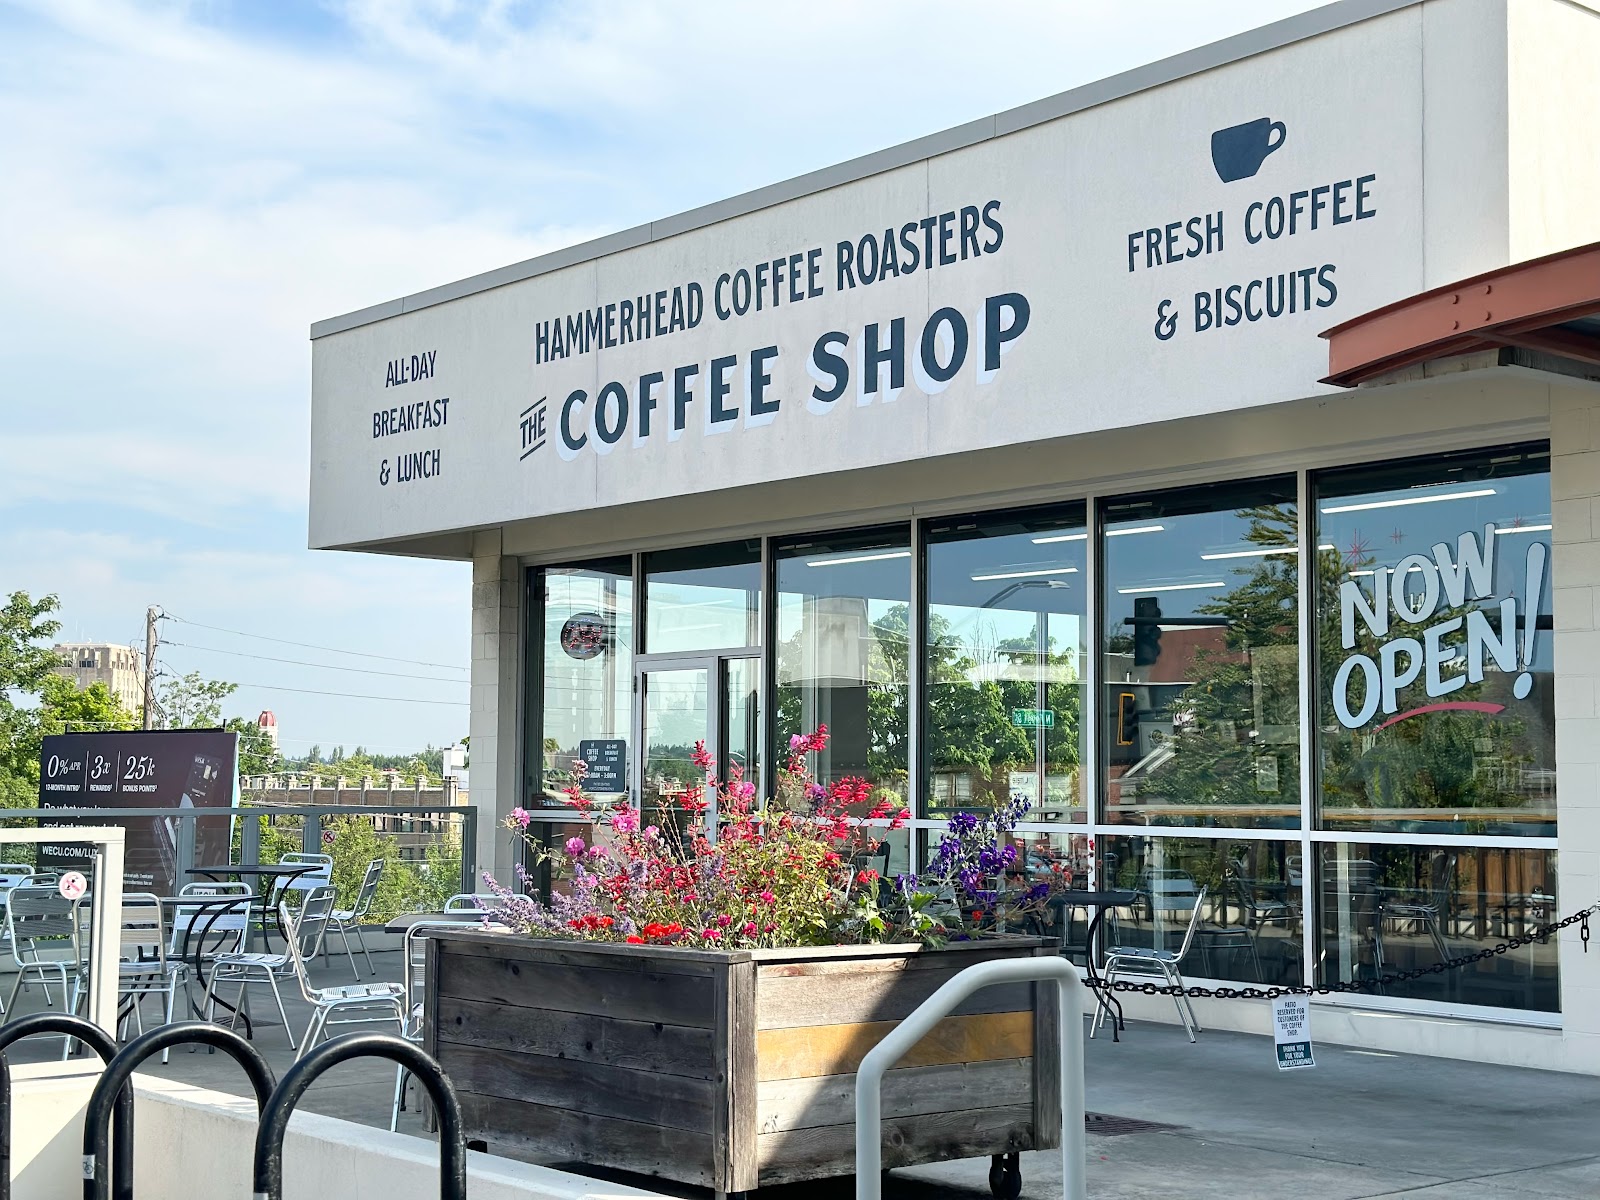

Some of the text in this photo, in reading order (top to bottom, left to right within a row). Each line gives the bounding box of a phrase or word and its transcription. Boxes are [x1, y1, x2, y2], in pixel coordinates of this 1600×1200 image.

[1128, 174, 1376, 272] FRESH COFFEE
[536, 200, 1004, 364] HAMMERHEAD COFFEE ROASTERS
[1154, 264, 1338, 340] & BISCUITS
[520, 292, 1030, 451] THE COFFEE SHOP
[373, 398, 450, 438] BREAKFAST
[380, 449, 440, 486] & LUNCH
[1340, 523, 1496, 649] NOW
[1332, 542, 1546, 728] OPEN!
[48, 755, 68, 778] 0%
[91, 756, 111, 779] 3x
[124, 756, 155, 780] 25k
